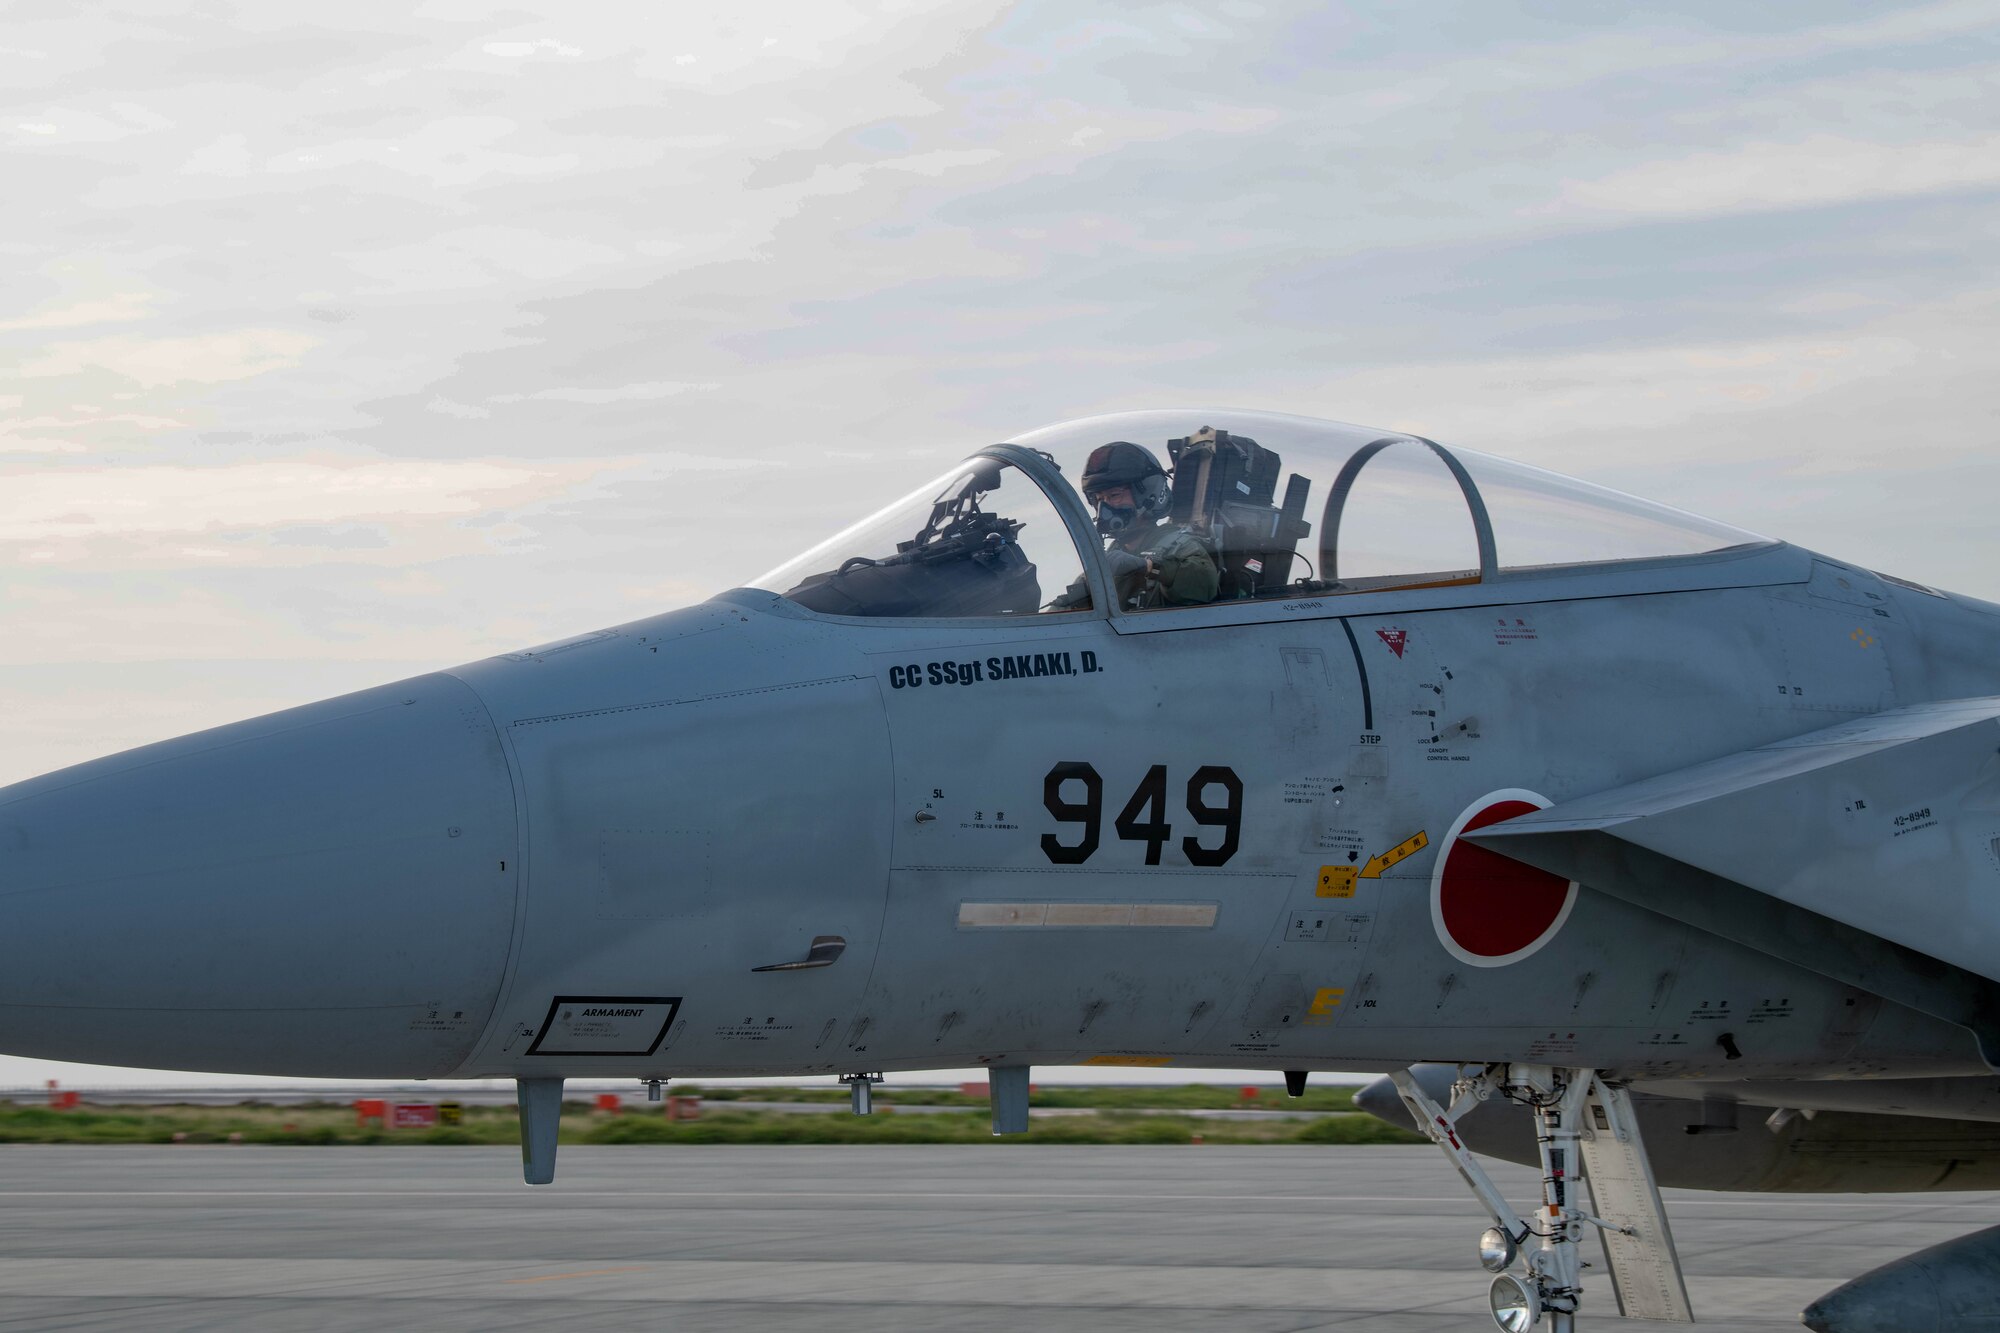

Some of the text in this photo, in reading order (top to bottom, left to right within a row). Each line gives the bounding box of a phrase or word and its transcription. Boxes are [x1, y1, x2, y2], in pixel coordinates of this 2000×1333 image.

[889, 650, 1103, 689] CC SSgt SAKAKI, D.
[1360, 735, 1381, 744] STEP
[932, 789, 945, 799] 5L
[974, 811, 1005, 821] 注意
[1040, 761, 1244, 867] 949
[1894, 808, 1931, 826] 42-8949
[1382, 838, 1422, 866] 救助用
[1323, 875, 1330, 885] 9
[1363, 1000, 1377, 1008] 10L
[582, 1008, 645, 1017] ARMAMENT
[1282, 1015, 1290, 1023] 8
[521, 1029, 534, 1037] 3L
